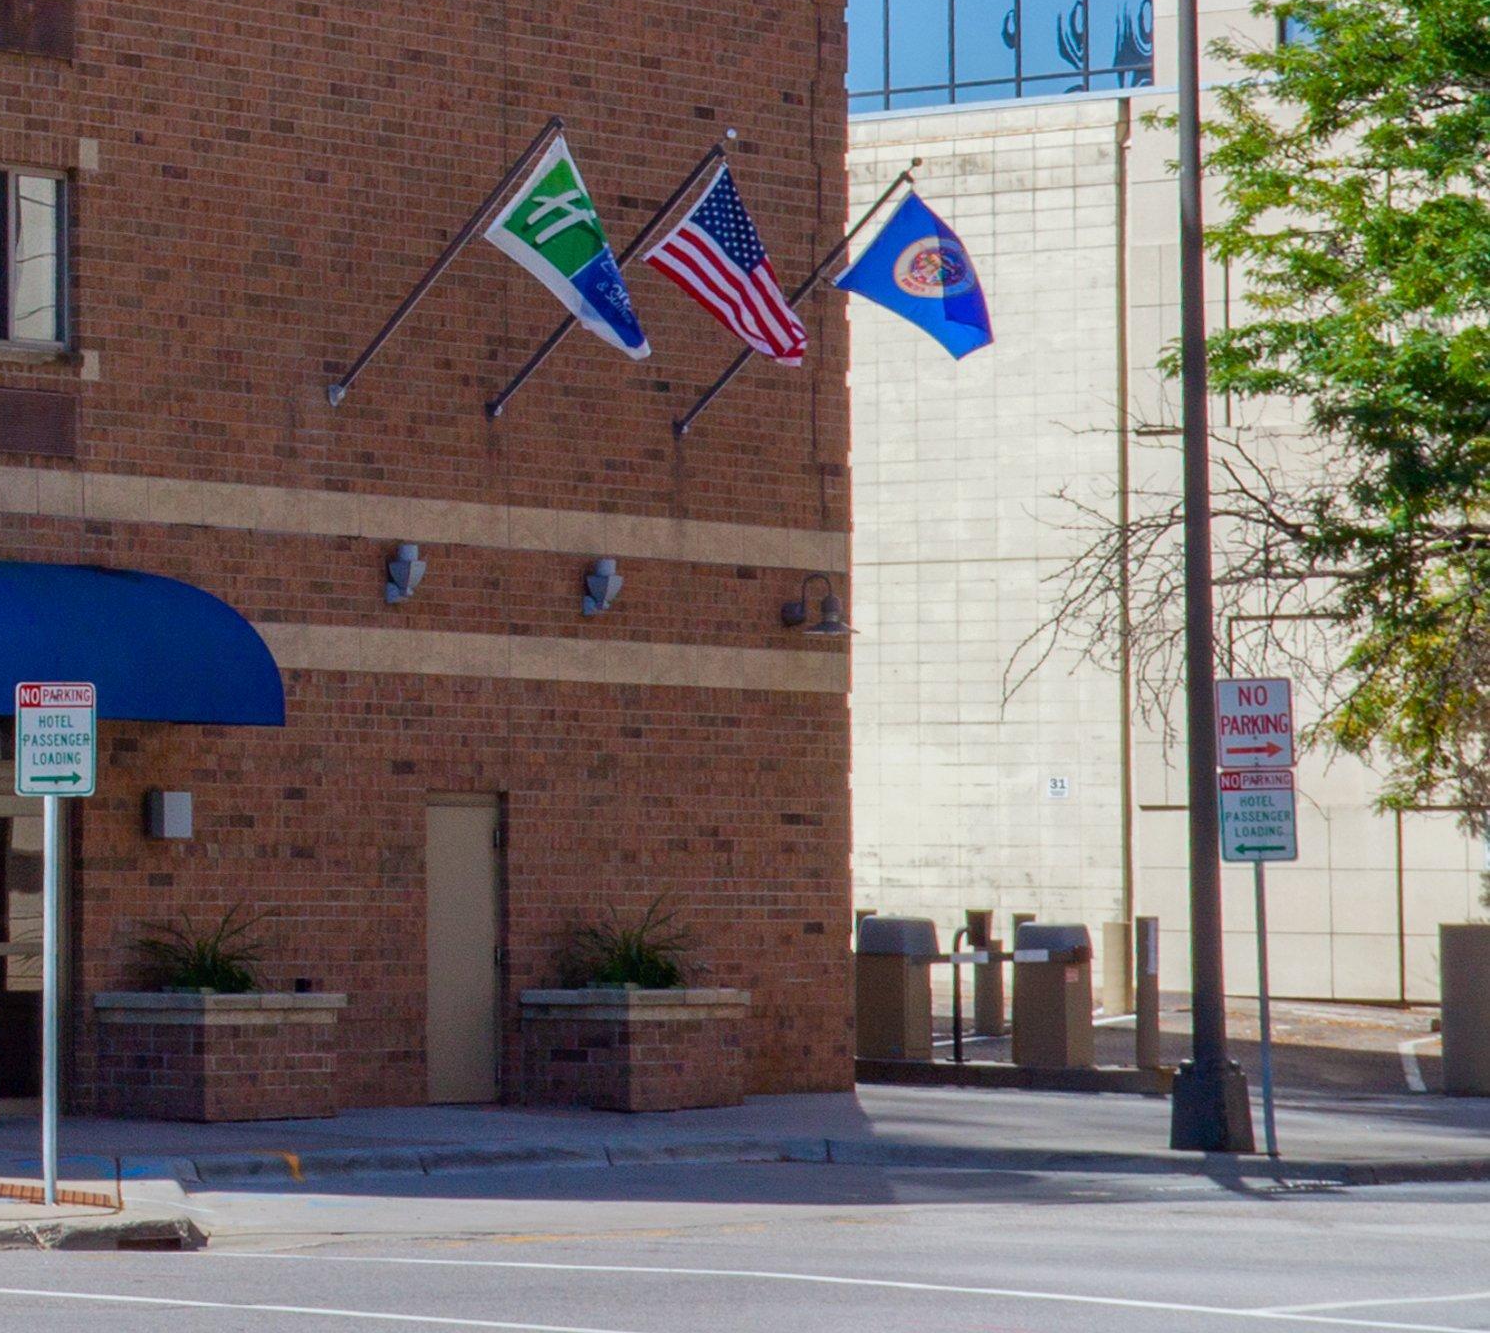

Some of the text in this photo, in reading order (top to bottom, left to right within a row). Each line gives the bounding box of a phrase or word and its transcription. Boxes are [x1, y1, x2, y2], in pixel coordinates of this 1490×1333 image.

[21, 687, 91, 704] NO PARKING
[1238, 686, 1268, 706] NO
[38, 715, 74, 728] HOTEL
[1221, 713, 1289, 735] PARKING
[22, 733, 91, 747] PASSENGER
[32, 752, 82, 765] LOADING
[1050, 778, 1066, 789] 31
[1221, 773, 1290, 789] NO PARKING
[1239, 796, 1275, 807] HOTEL
[1225, 811, 1291, 823] PASSENGER
[1235, 825, 1284, 838] LOADING
